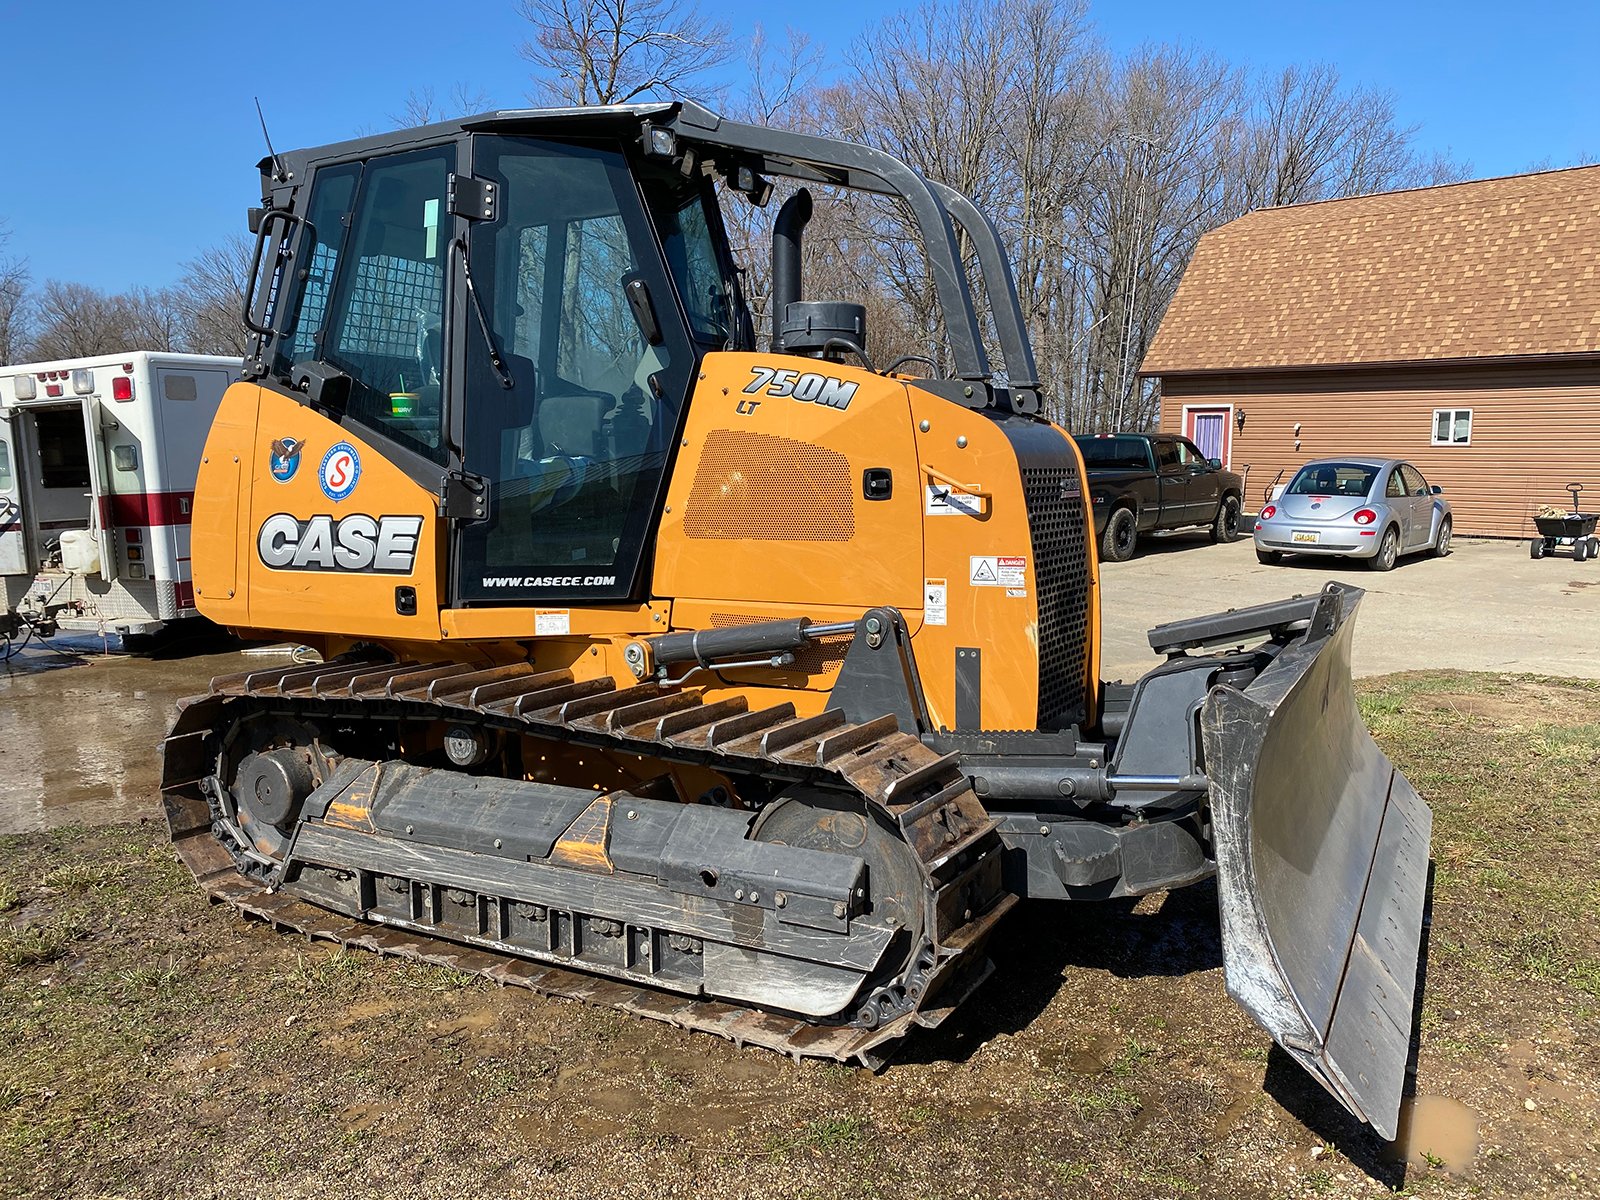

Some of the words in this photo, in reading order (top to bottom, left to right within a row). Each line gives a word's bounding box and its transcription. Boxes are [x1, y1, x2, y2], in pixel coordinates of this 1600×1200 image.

[742, 366, 860, 410] 750M
[736, 400, 761, 415] LT
[330, 456, 350, 487] S
[257, 513, 424, 571] CASE
[482, 576, 616, 587] WWW.CASECE.COM
